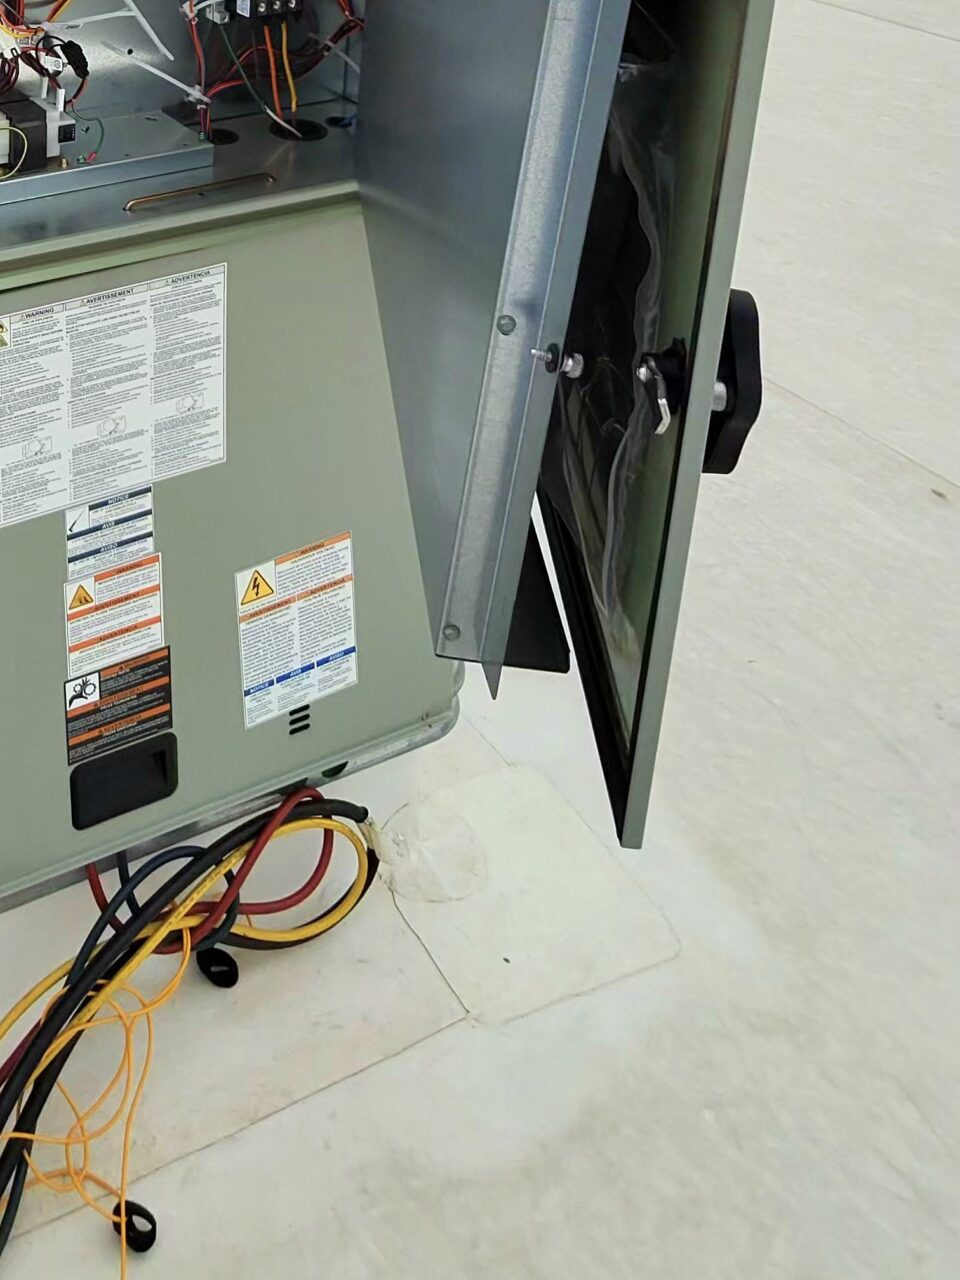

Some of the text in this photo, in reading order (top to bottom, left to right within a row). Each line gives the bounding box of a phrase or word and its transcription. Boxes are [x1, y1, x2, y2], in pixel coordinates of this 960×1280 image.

[170, 270, 210, 284] ADVERTENCIA
[86, 288, 134, 304] AVERTISSEMENT
[25, 308, 55, 318] WARNING
[108, 493, 129, 504] NOTICE
[290, 668, 302, 677] AVIS
[250, 682, 270, 693] NOTICE
